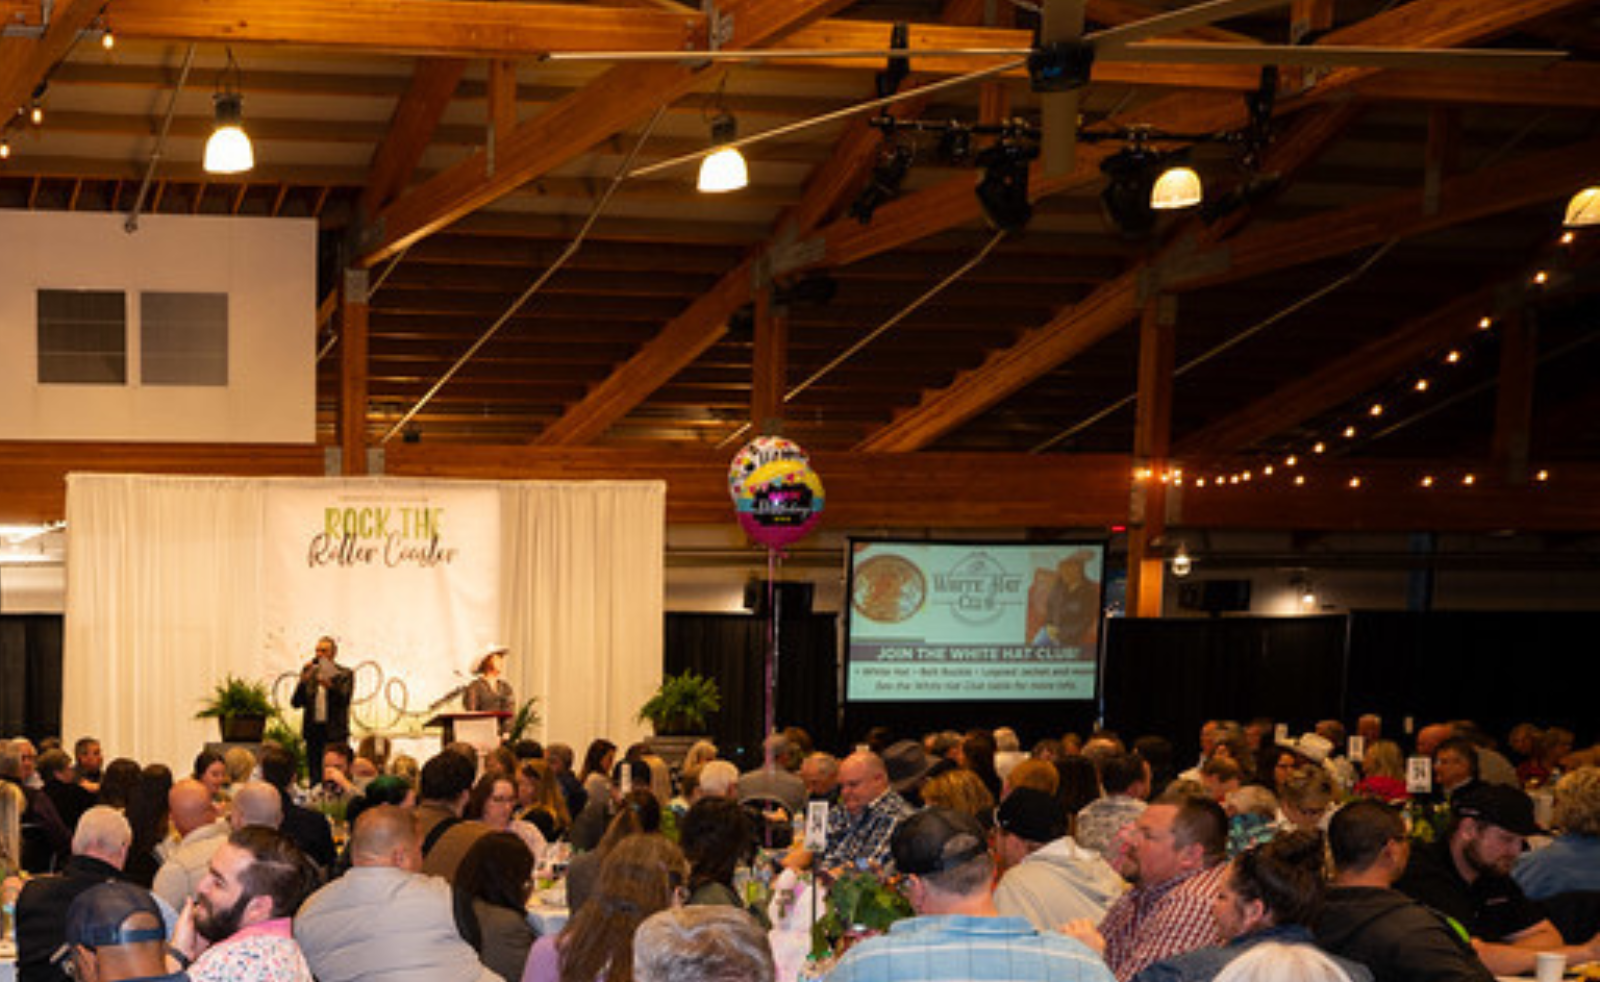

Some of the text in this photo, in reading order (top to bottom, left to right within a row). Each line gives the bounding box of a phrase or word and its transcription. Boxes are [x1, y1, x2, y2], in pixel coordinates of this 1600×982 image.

[324, 507, 445, 539] ROCK THE
[308, 530, 460, 568] Roller Coaster
